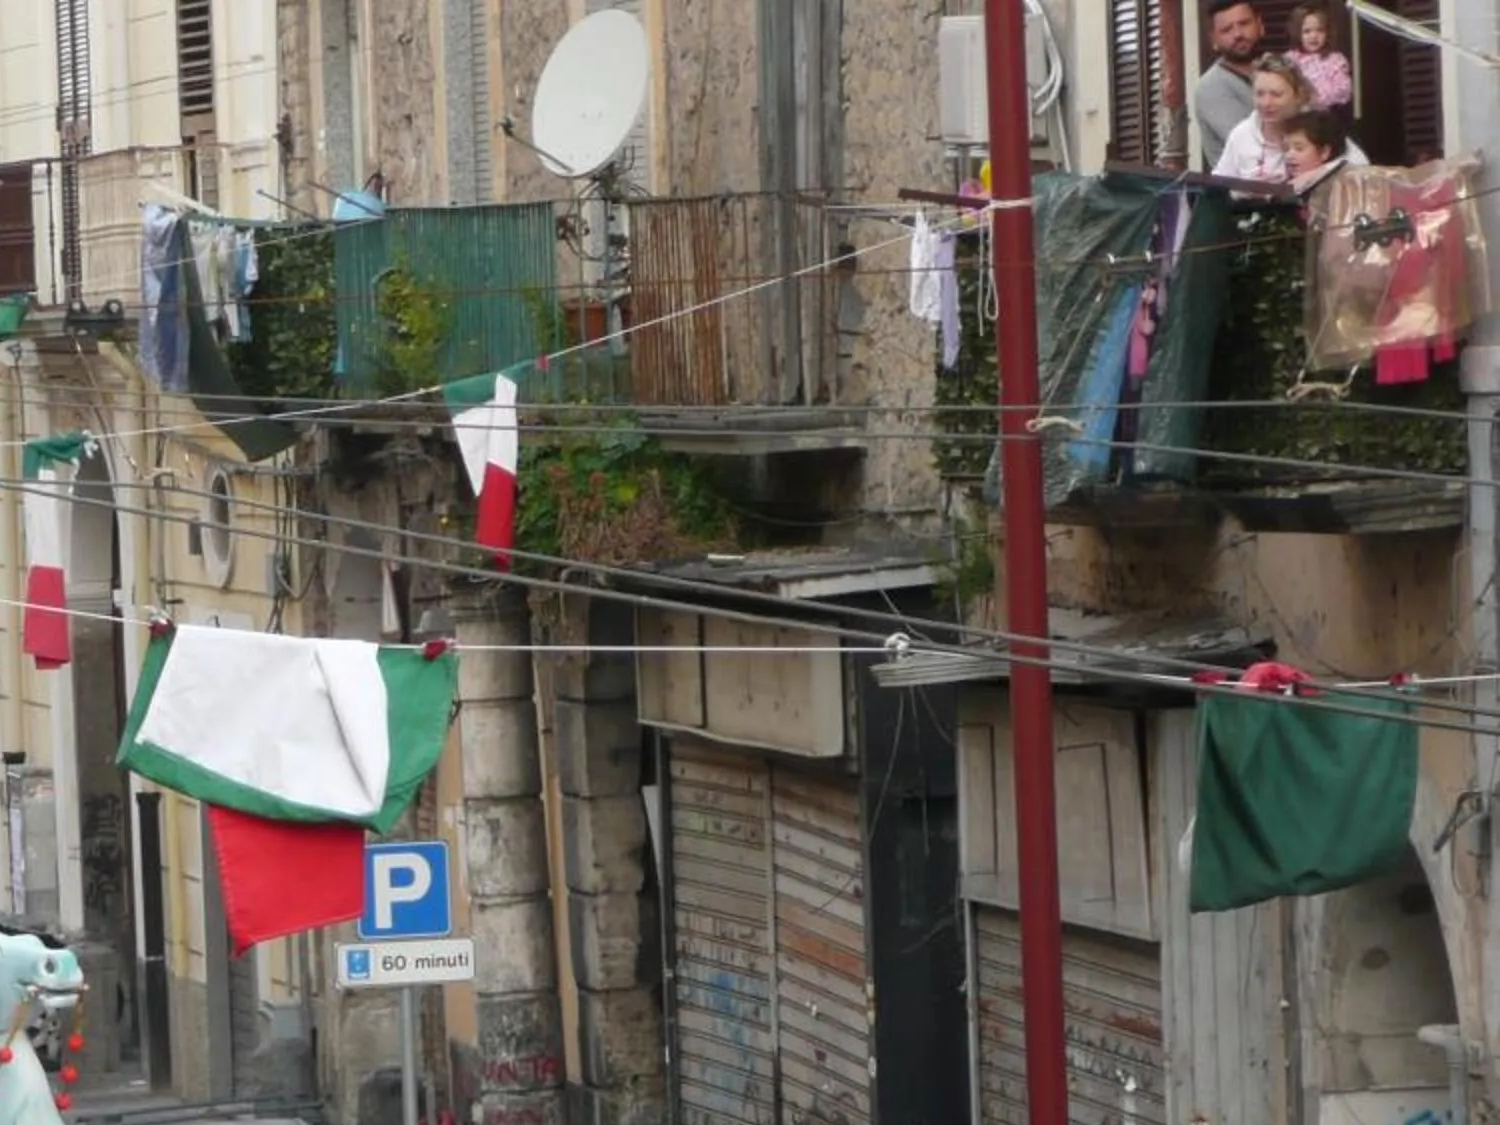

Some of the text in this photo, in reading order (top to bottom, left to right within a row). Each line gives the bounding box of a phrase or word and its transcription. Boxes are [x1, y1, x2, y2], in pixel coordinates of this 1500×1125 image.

[372, 851, 432, 930] P
[380, 951, 469, 972] 60 minuti
